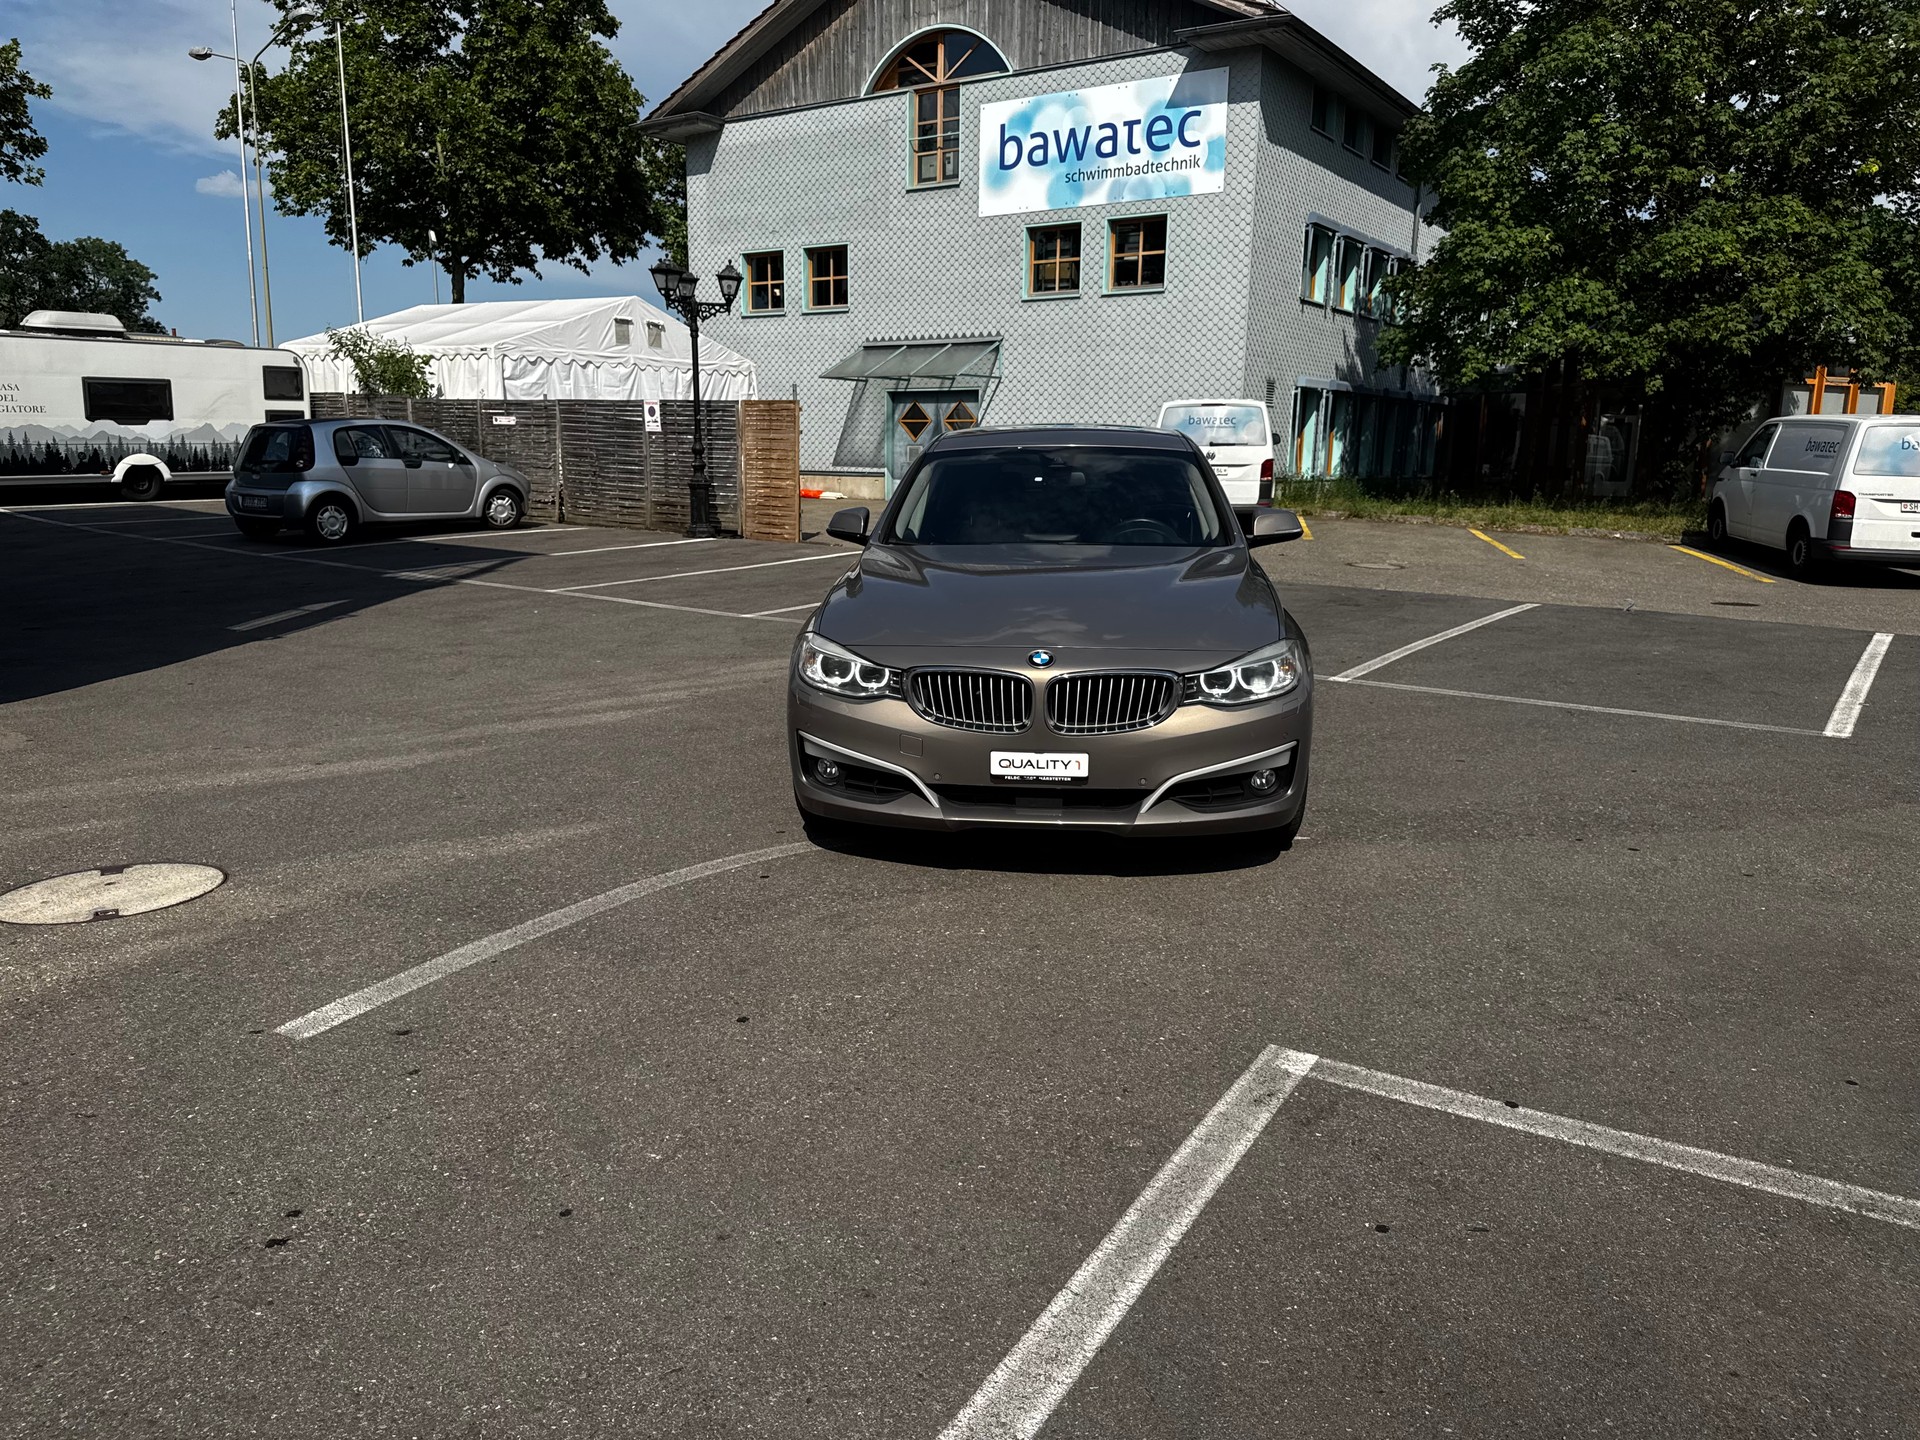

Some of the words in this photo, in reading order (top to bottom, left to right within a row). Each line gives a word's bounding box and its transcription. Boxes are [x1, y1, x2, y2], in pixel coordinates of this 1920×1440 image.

[999, 109, 1202, 171] bawatec
[1064, 154, 1201, 184] schwimmbadtechnik
[1805, 437, 1840, 453] bawatec
[998, 758, 1072, 770] QUALITY
[1075, 760, 1081, 770] 1
